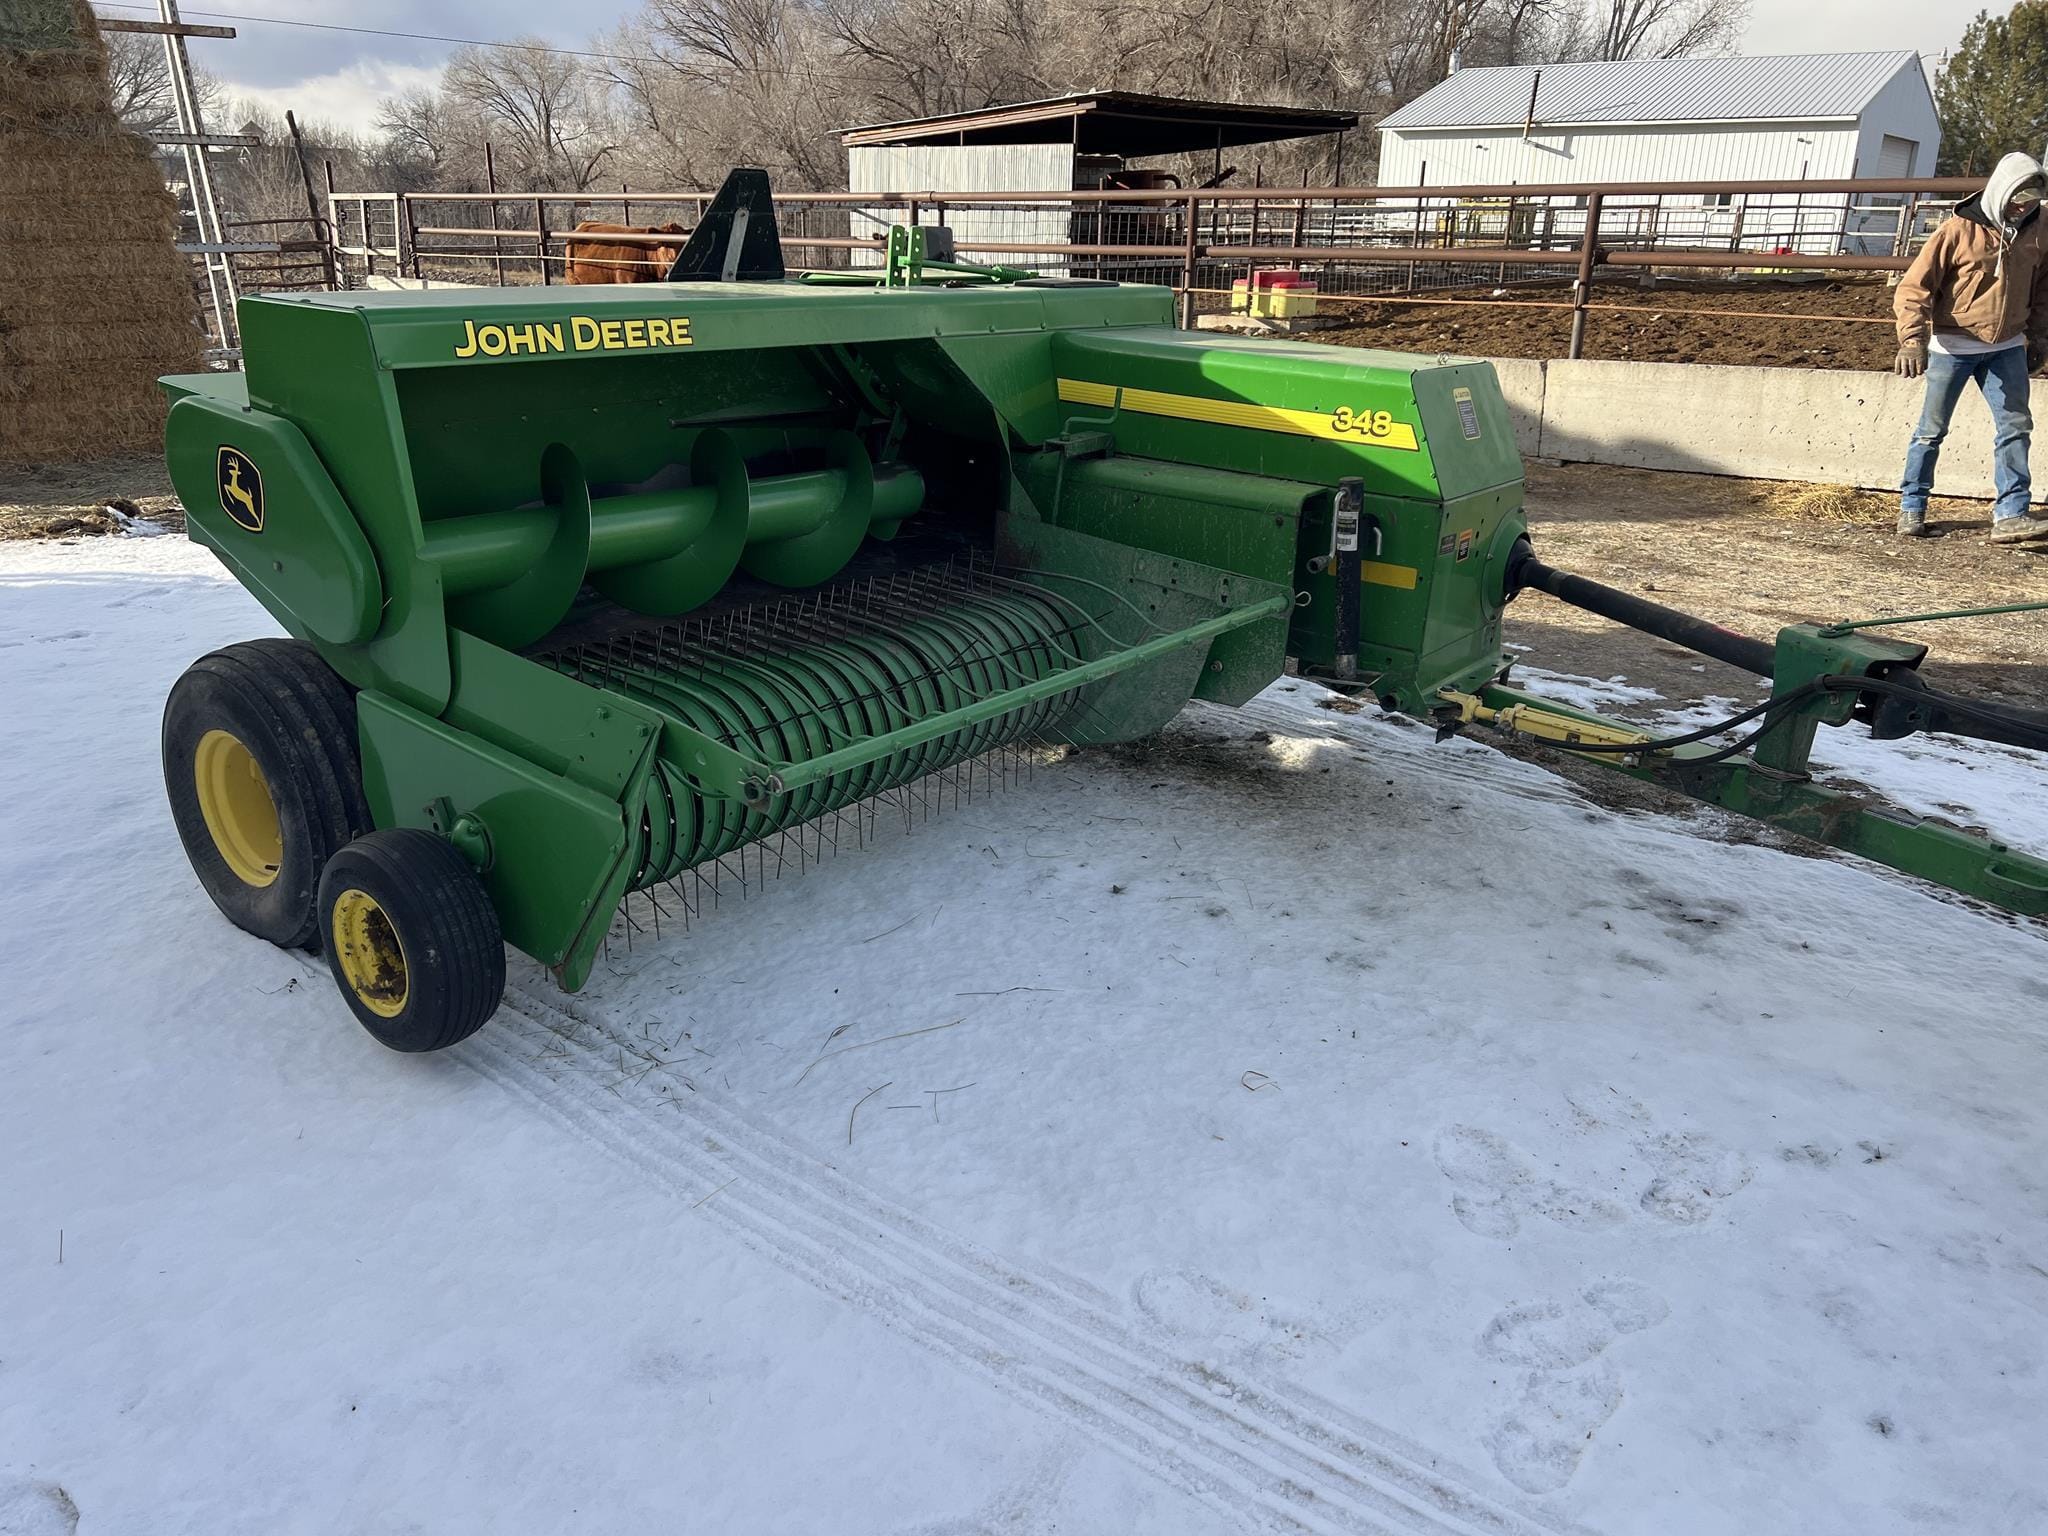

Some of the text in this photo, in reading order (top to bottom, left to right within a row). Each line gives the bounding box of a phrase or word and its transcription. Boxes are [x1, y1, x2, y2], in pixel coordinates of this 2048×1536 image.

[455, 316, 693, 358] JOHN DEERE
[1332, 406, 1392, 437] 348
